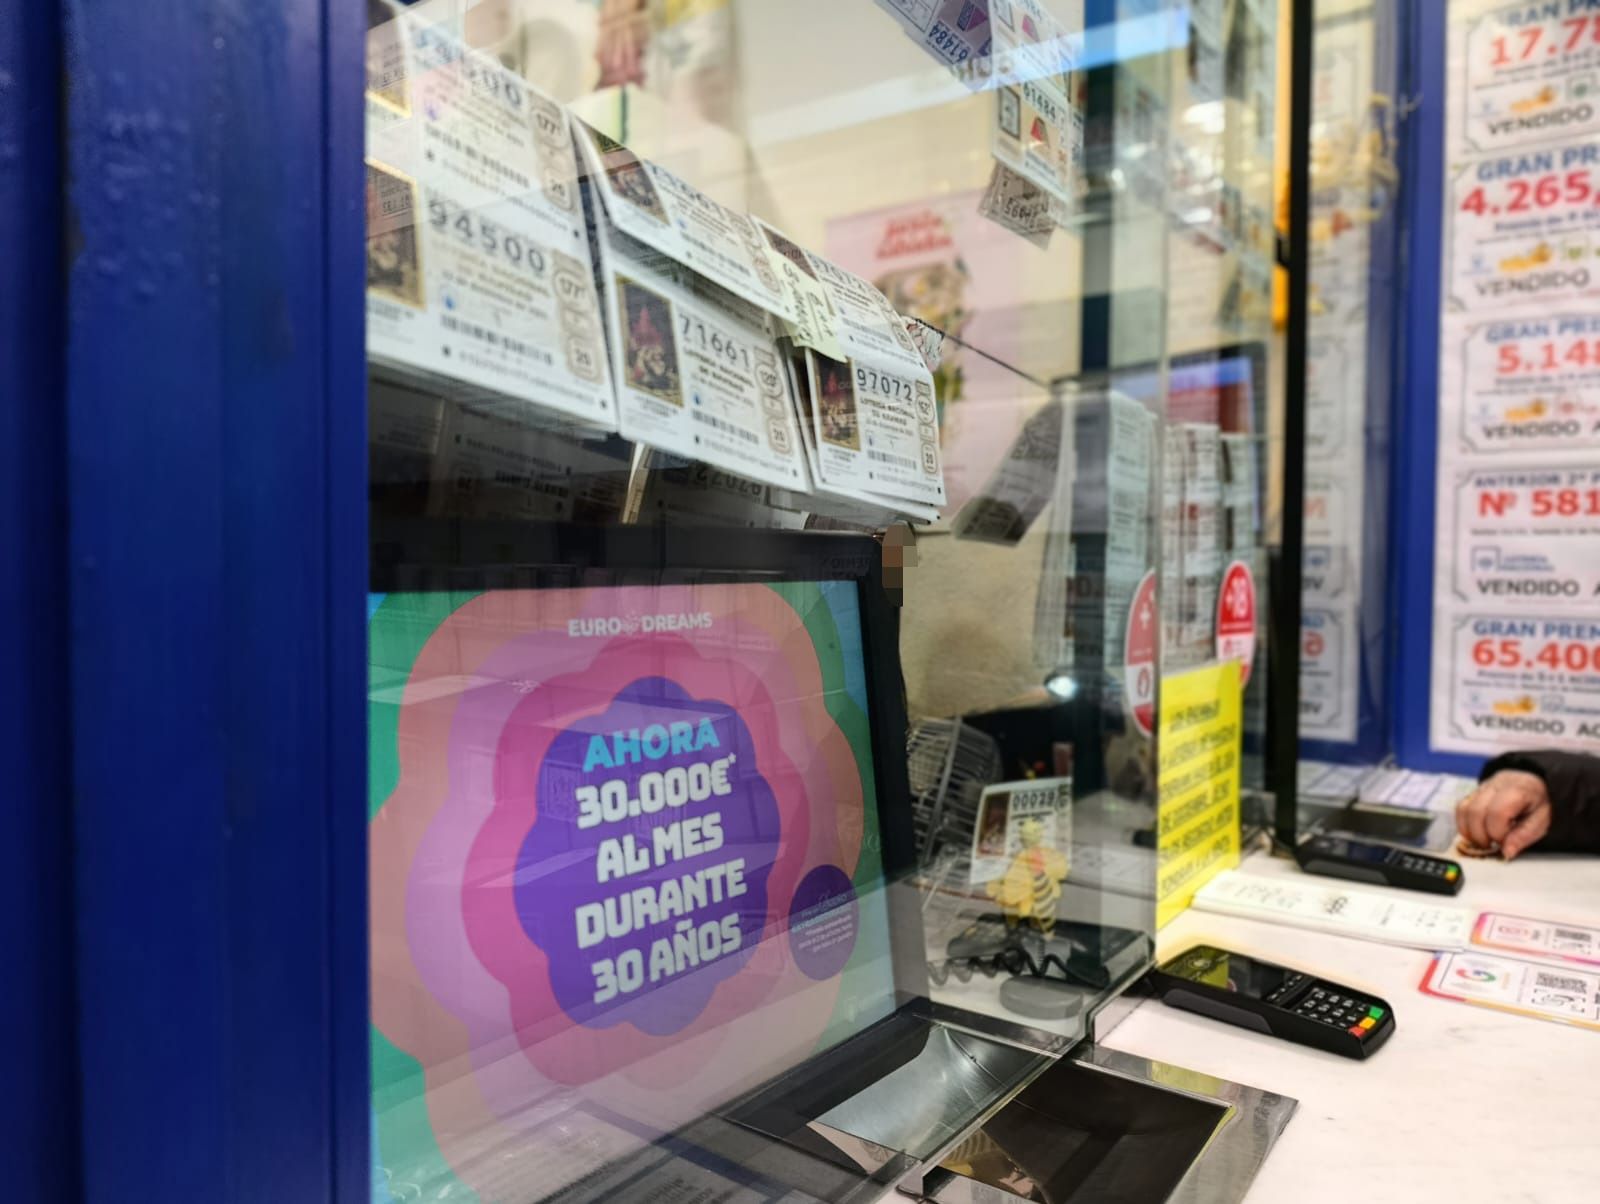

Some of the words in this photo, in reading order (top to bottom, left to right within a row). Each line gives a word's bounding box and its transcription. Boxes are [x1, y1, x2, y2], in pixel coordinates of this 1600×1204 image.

[1488, 104, 1593, 136] VENDIDO
[1477, 153, 1553, 181] GRAN
[427, 200, 546, 275] 94500
[1475, 267, 1590, 296] VENDIDO
[678, 312, 750, 371] 71661
[1485, 322, 1549, 343] GRAN
[857, 368, 913, 402] 97072
[1482, 420, 1580, 440] VENDIDO
[1477, 578, 1581, 598] VENDIDO
[568, 617, 622, 637] EURO
[640, 612, 713, 633] DREAMS
[1473, 620, 1537, 637] GRAN
[1470, 714, 1566, 736] VENDIDO
[583, 717, 721, 773] AHORA
[596, 834, 650, 883] AL
[652, 812, 724, 867] MES
[575, 857, 748, 950] DURANTE
[591, 948, 644, 1004] 30
[649, 912, 743, 983] AÑOS
